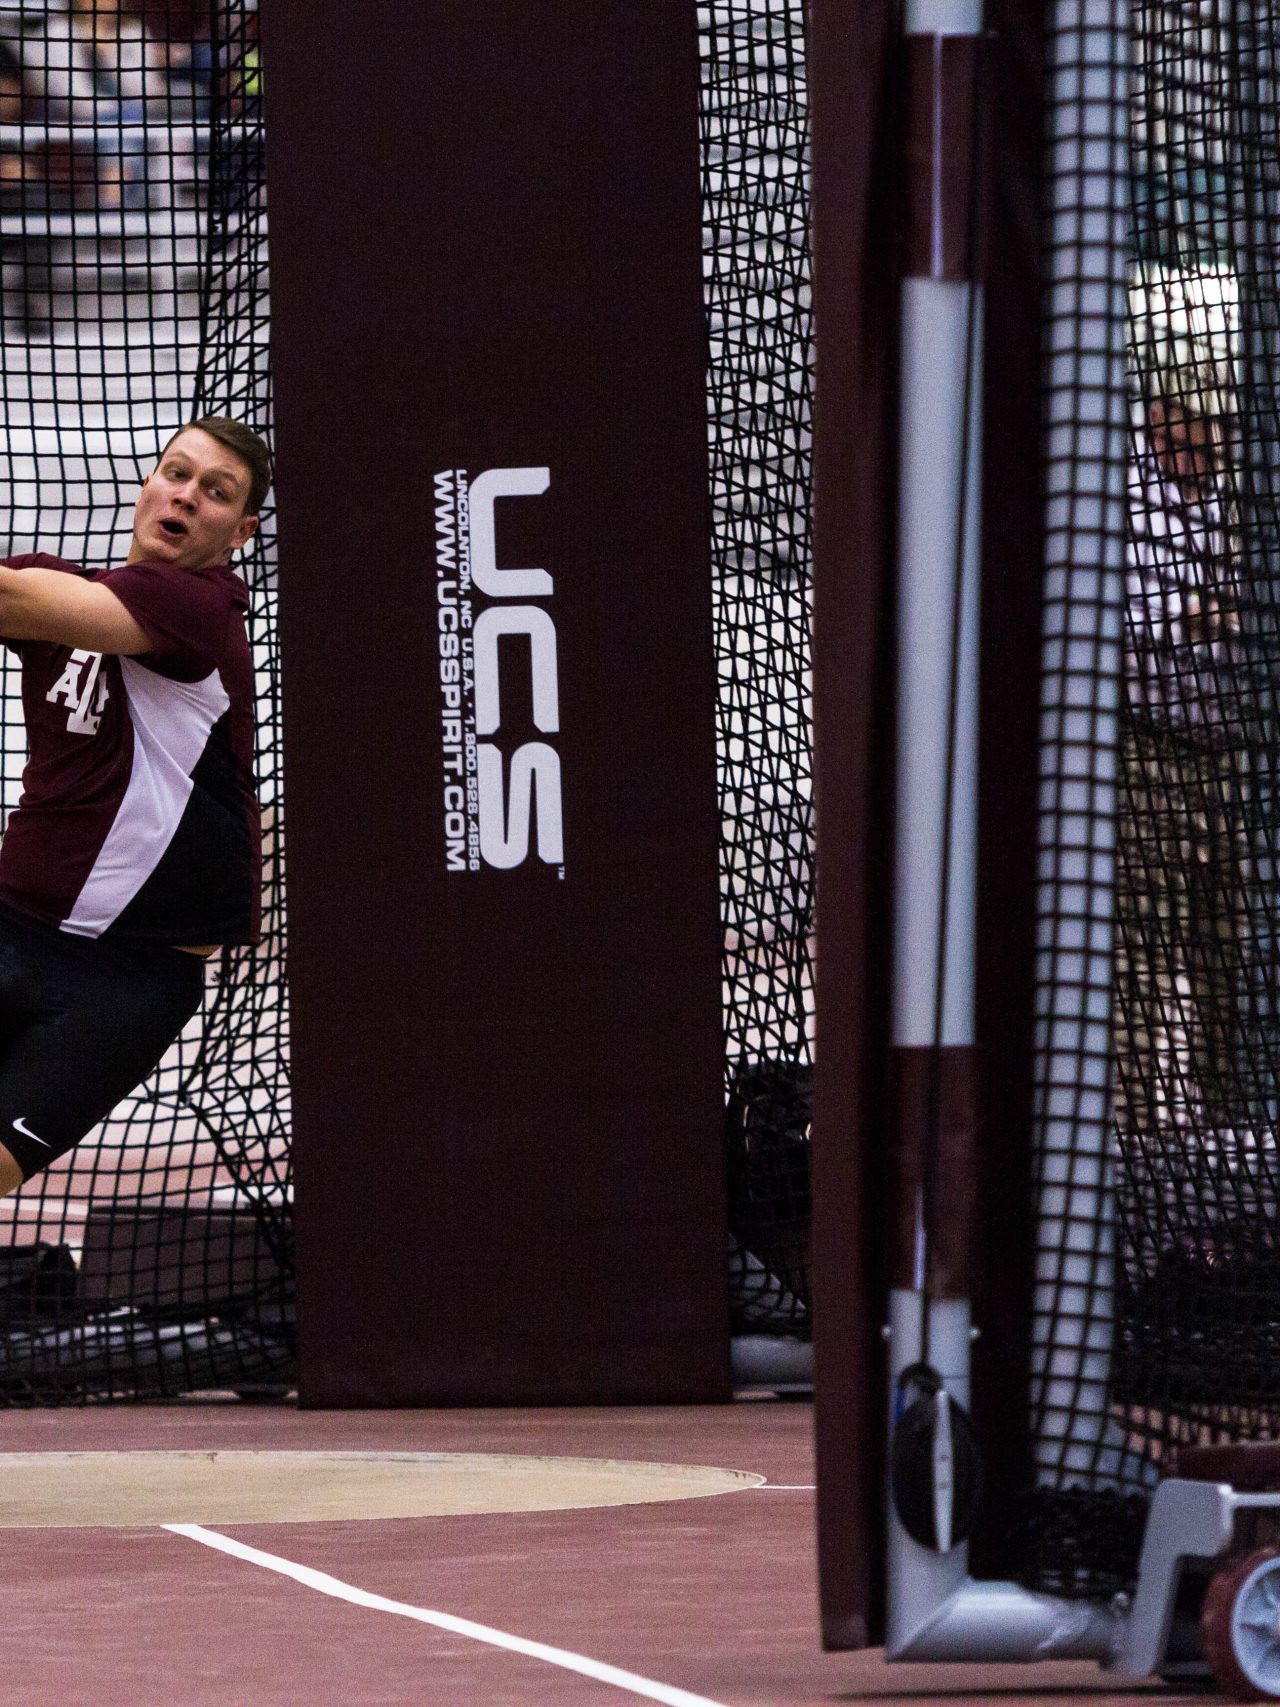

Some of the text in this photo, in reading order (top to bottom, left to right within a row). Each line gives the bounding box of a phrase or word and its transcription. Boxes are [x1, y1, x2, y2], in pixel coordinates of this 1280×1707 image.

[456, 469, 471, 595] LINCOLNTON,
[433, 469, 466, 871] WWW.UCSSPIRIT.COM
[460, 601, 473, 628] NC
[462, 638, 474, 696] U.S.A.
[469, 467, 564, 870] UCS
